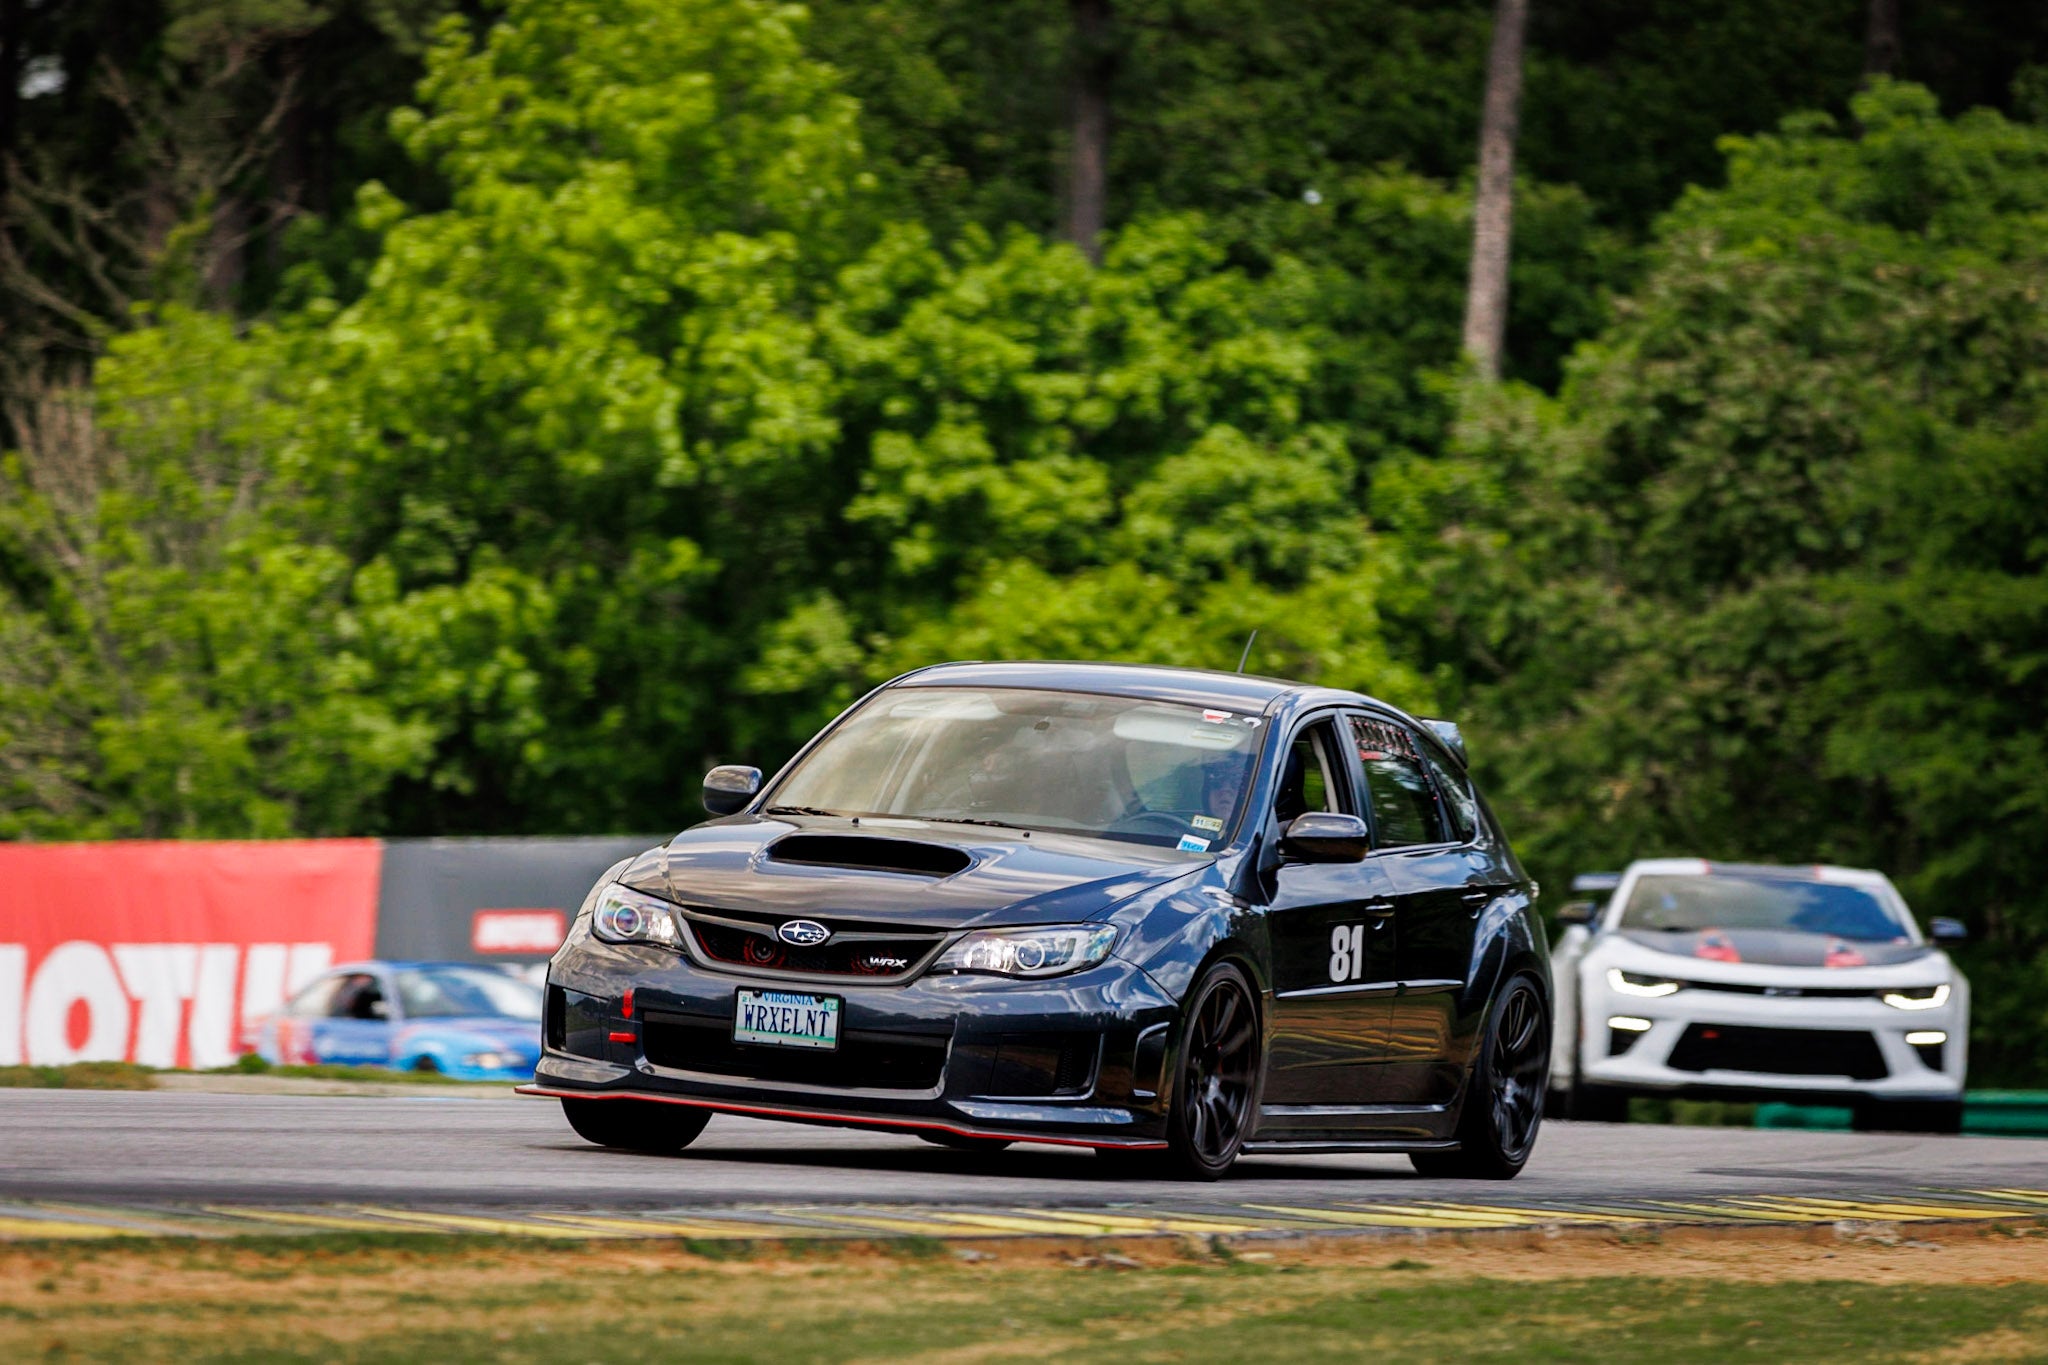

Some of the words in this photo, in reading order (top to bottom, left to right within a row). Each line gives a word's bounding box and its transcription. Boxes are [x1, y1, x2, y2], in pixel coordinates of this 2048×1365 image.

[870, 957, 907, 968] WRX
[1328, 925, 1364, 982] 81
[0, 940, 334, 1069] OTU
[762, 992, 813, 1006] VIRGINIA
[744, 1004, 830, 1037] WRXELNT
